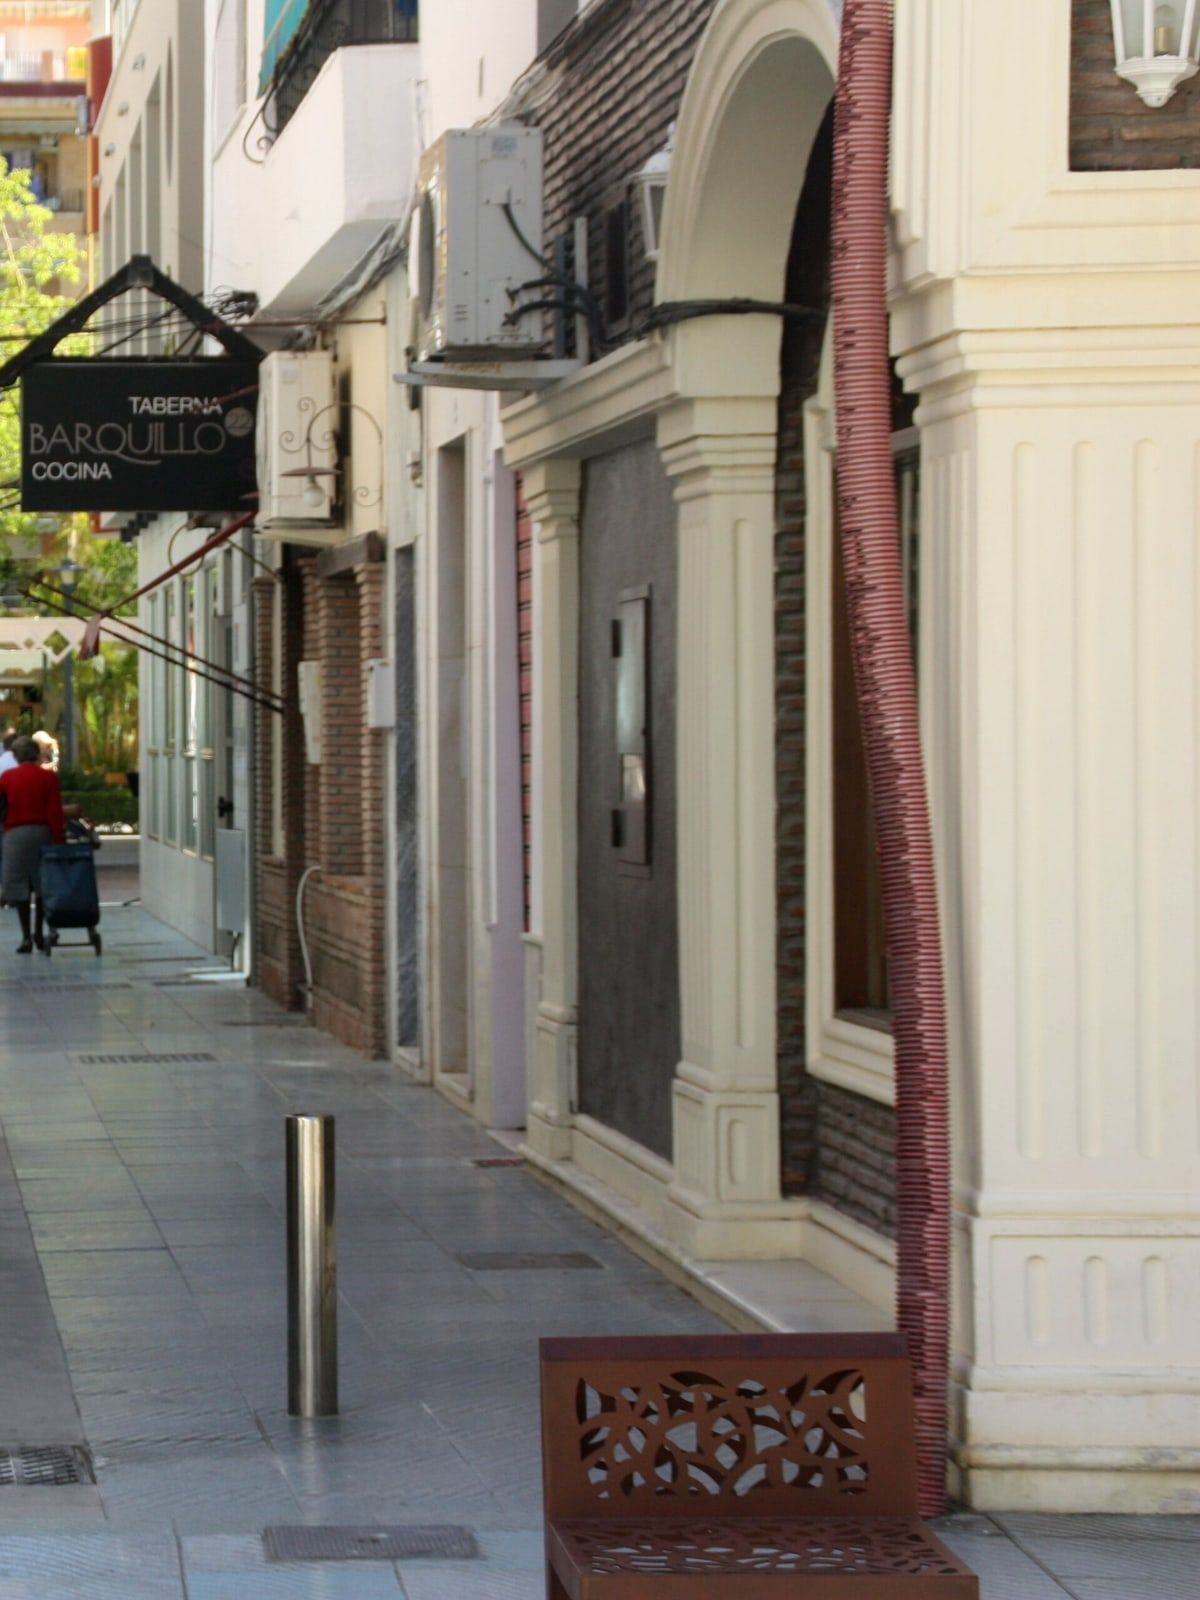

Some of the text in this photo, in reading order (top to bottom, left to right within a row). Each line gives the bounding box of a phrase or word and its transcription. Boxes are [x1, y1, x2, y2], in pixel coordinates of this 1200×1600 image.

[129, 396, 223, 415] TABERNA
[29, 422, 227, 465] BARQUILLO
[31, 461, 112, 480] COCINA
